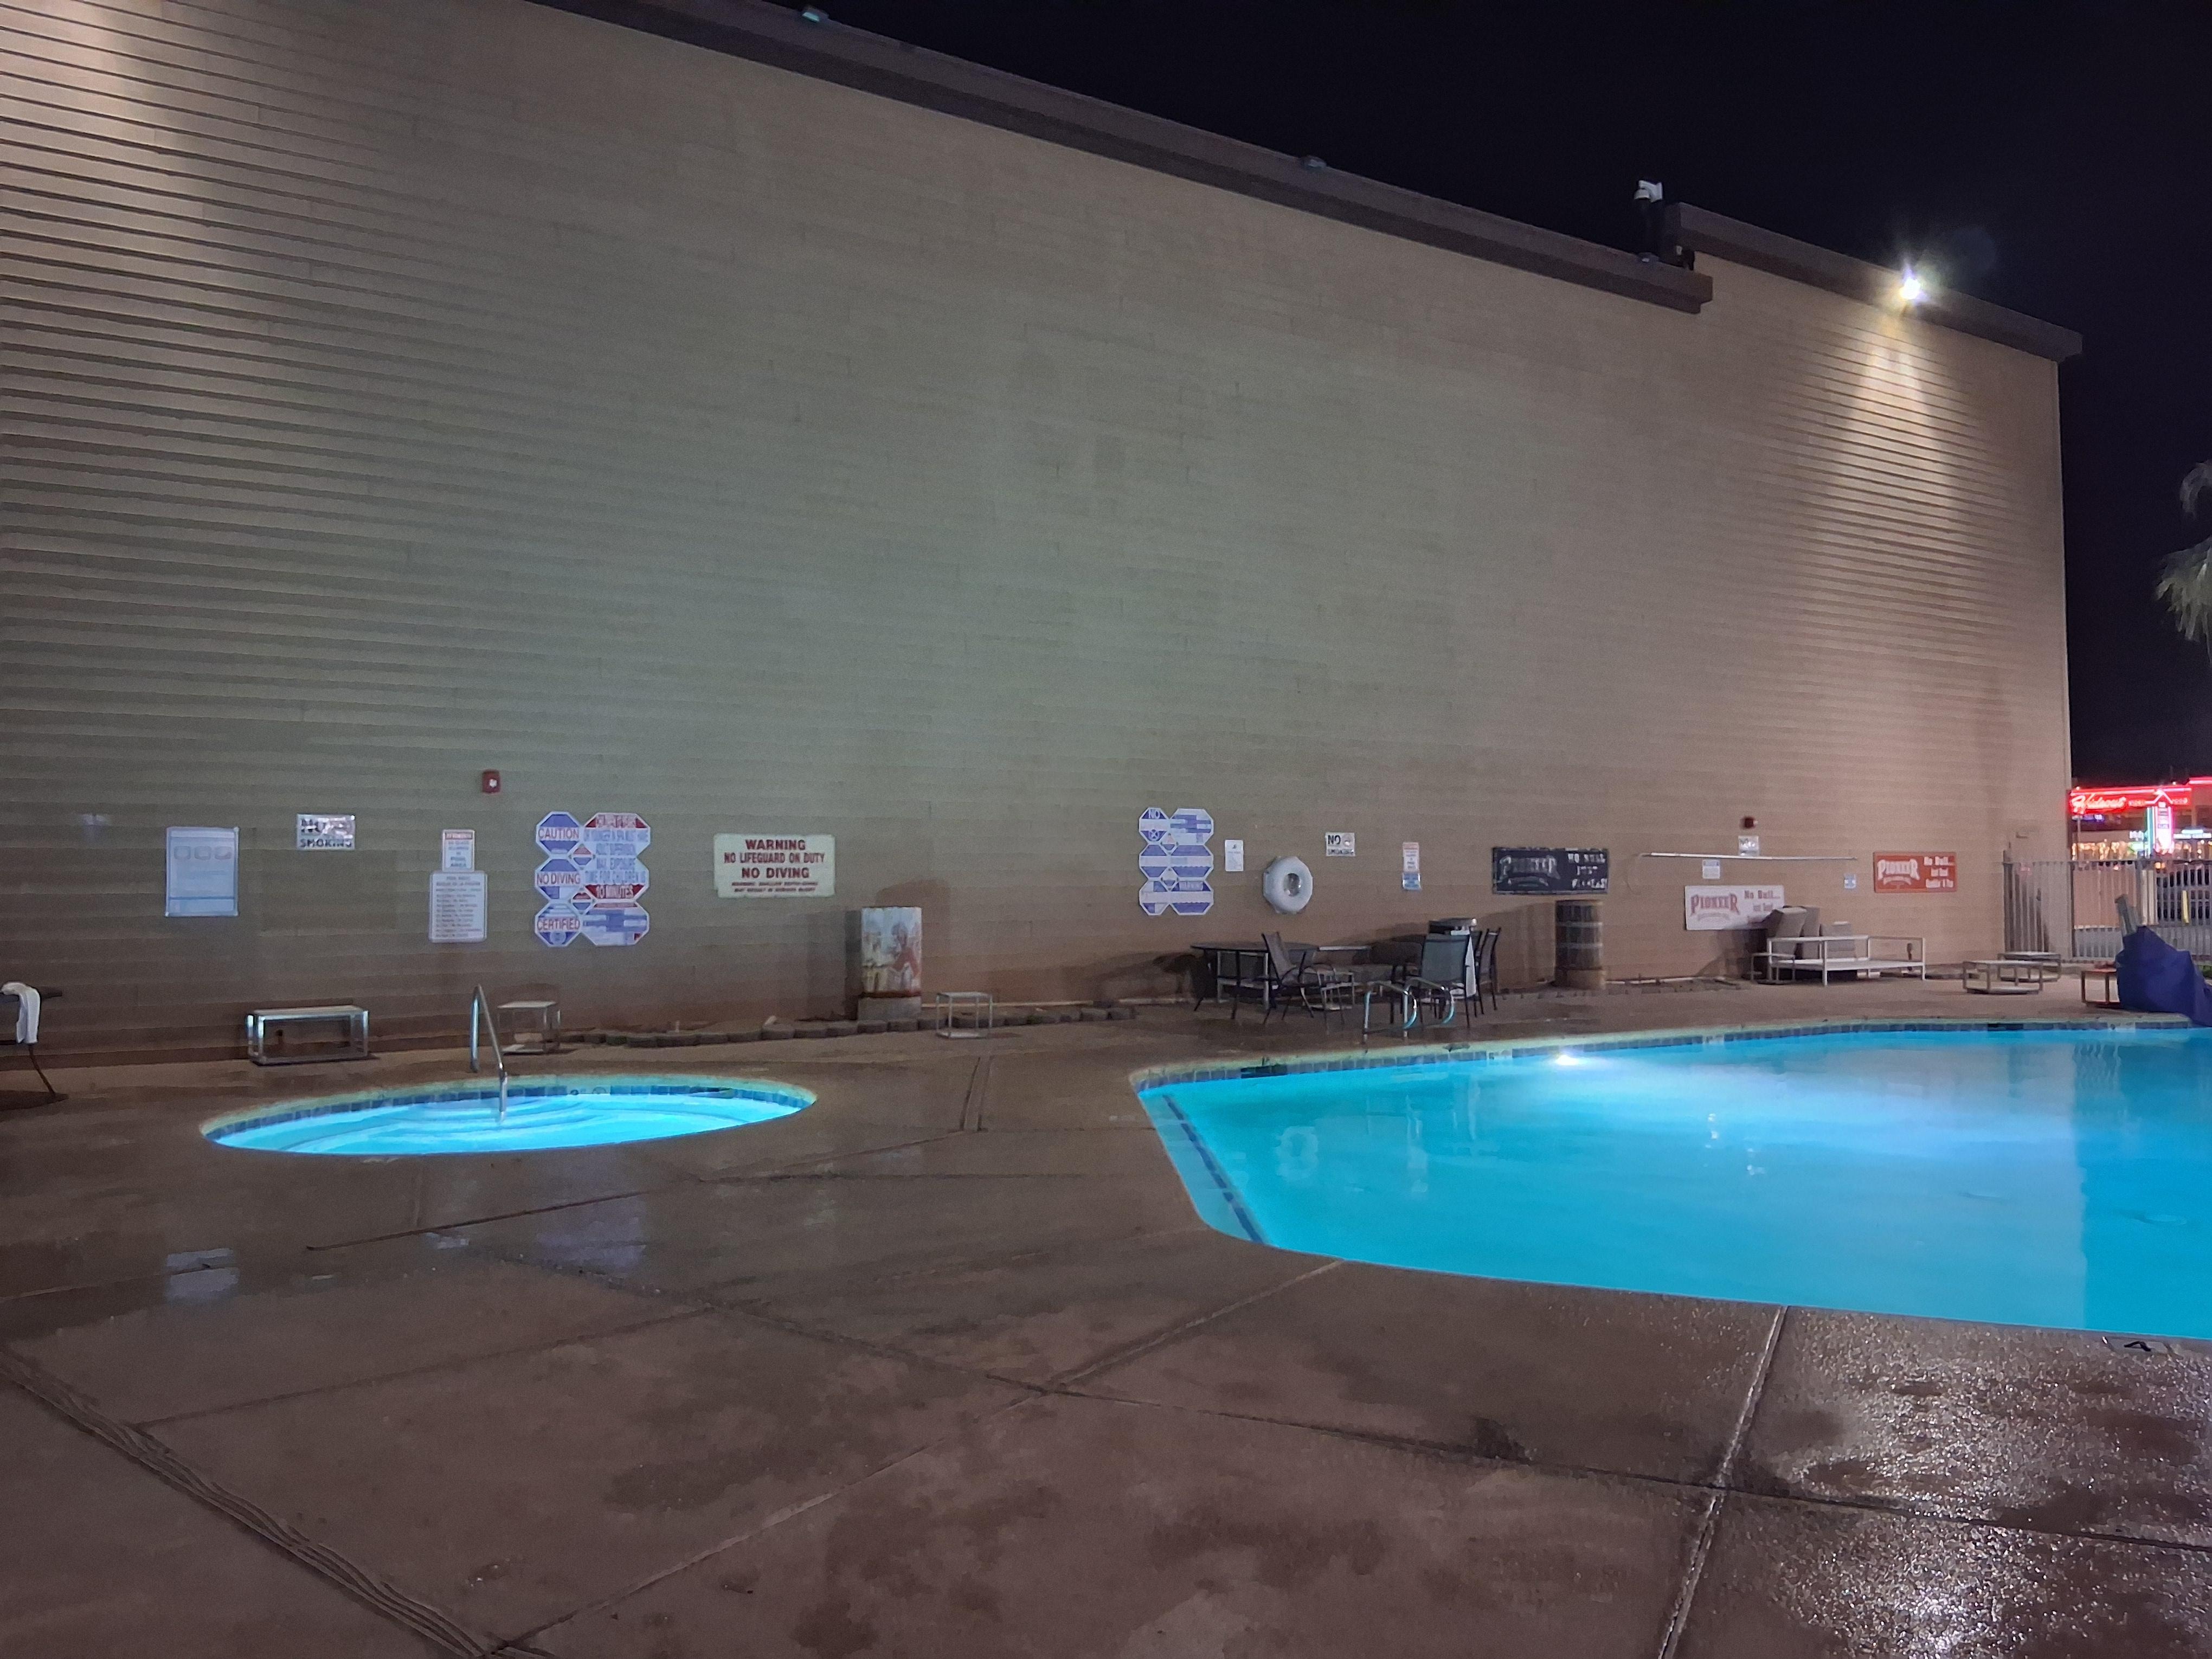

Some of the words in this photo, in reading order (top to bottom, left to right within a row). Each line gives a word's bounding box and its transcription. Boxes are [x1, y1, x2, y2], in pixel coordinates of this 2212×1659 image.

[538, 828, 579, 839] CAUTION
[745, 839, 806, 850] WARNING
[1328, 835, 1341, 844] NO
[724, 852, 736, 863] NO
[740, 852, 785, 863] LIFEGUARD
[789, 852, 800, 863] ON
[803, 852, 825, 863] DUTY
[742, 867, 760, 878] NO
[766, 867, 809, 878] DIVING
[537, 873, 549, 885] NO
[551, 872, 581, 885] DIVING
[537, 918, 580, 930] CERTIFIED
